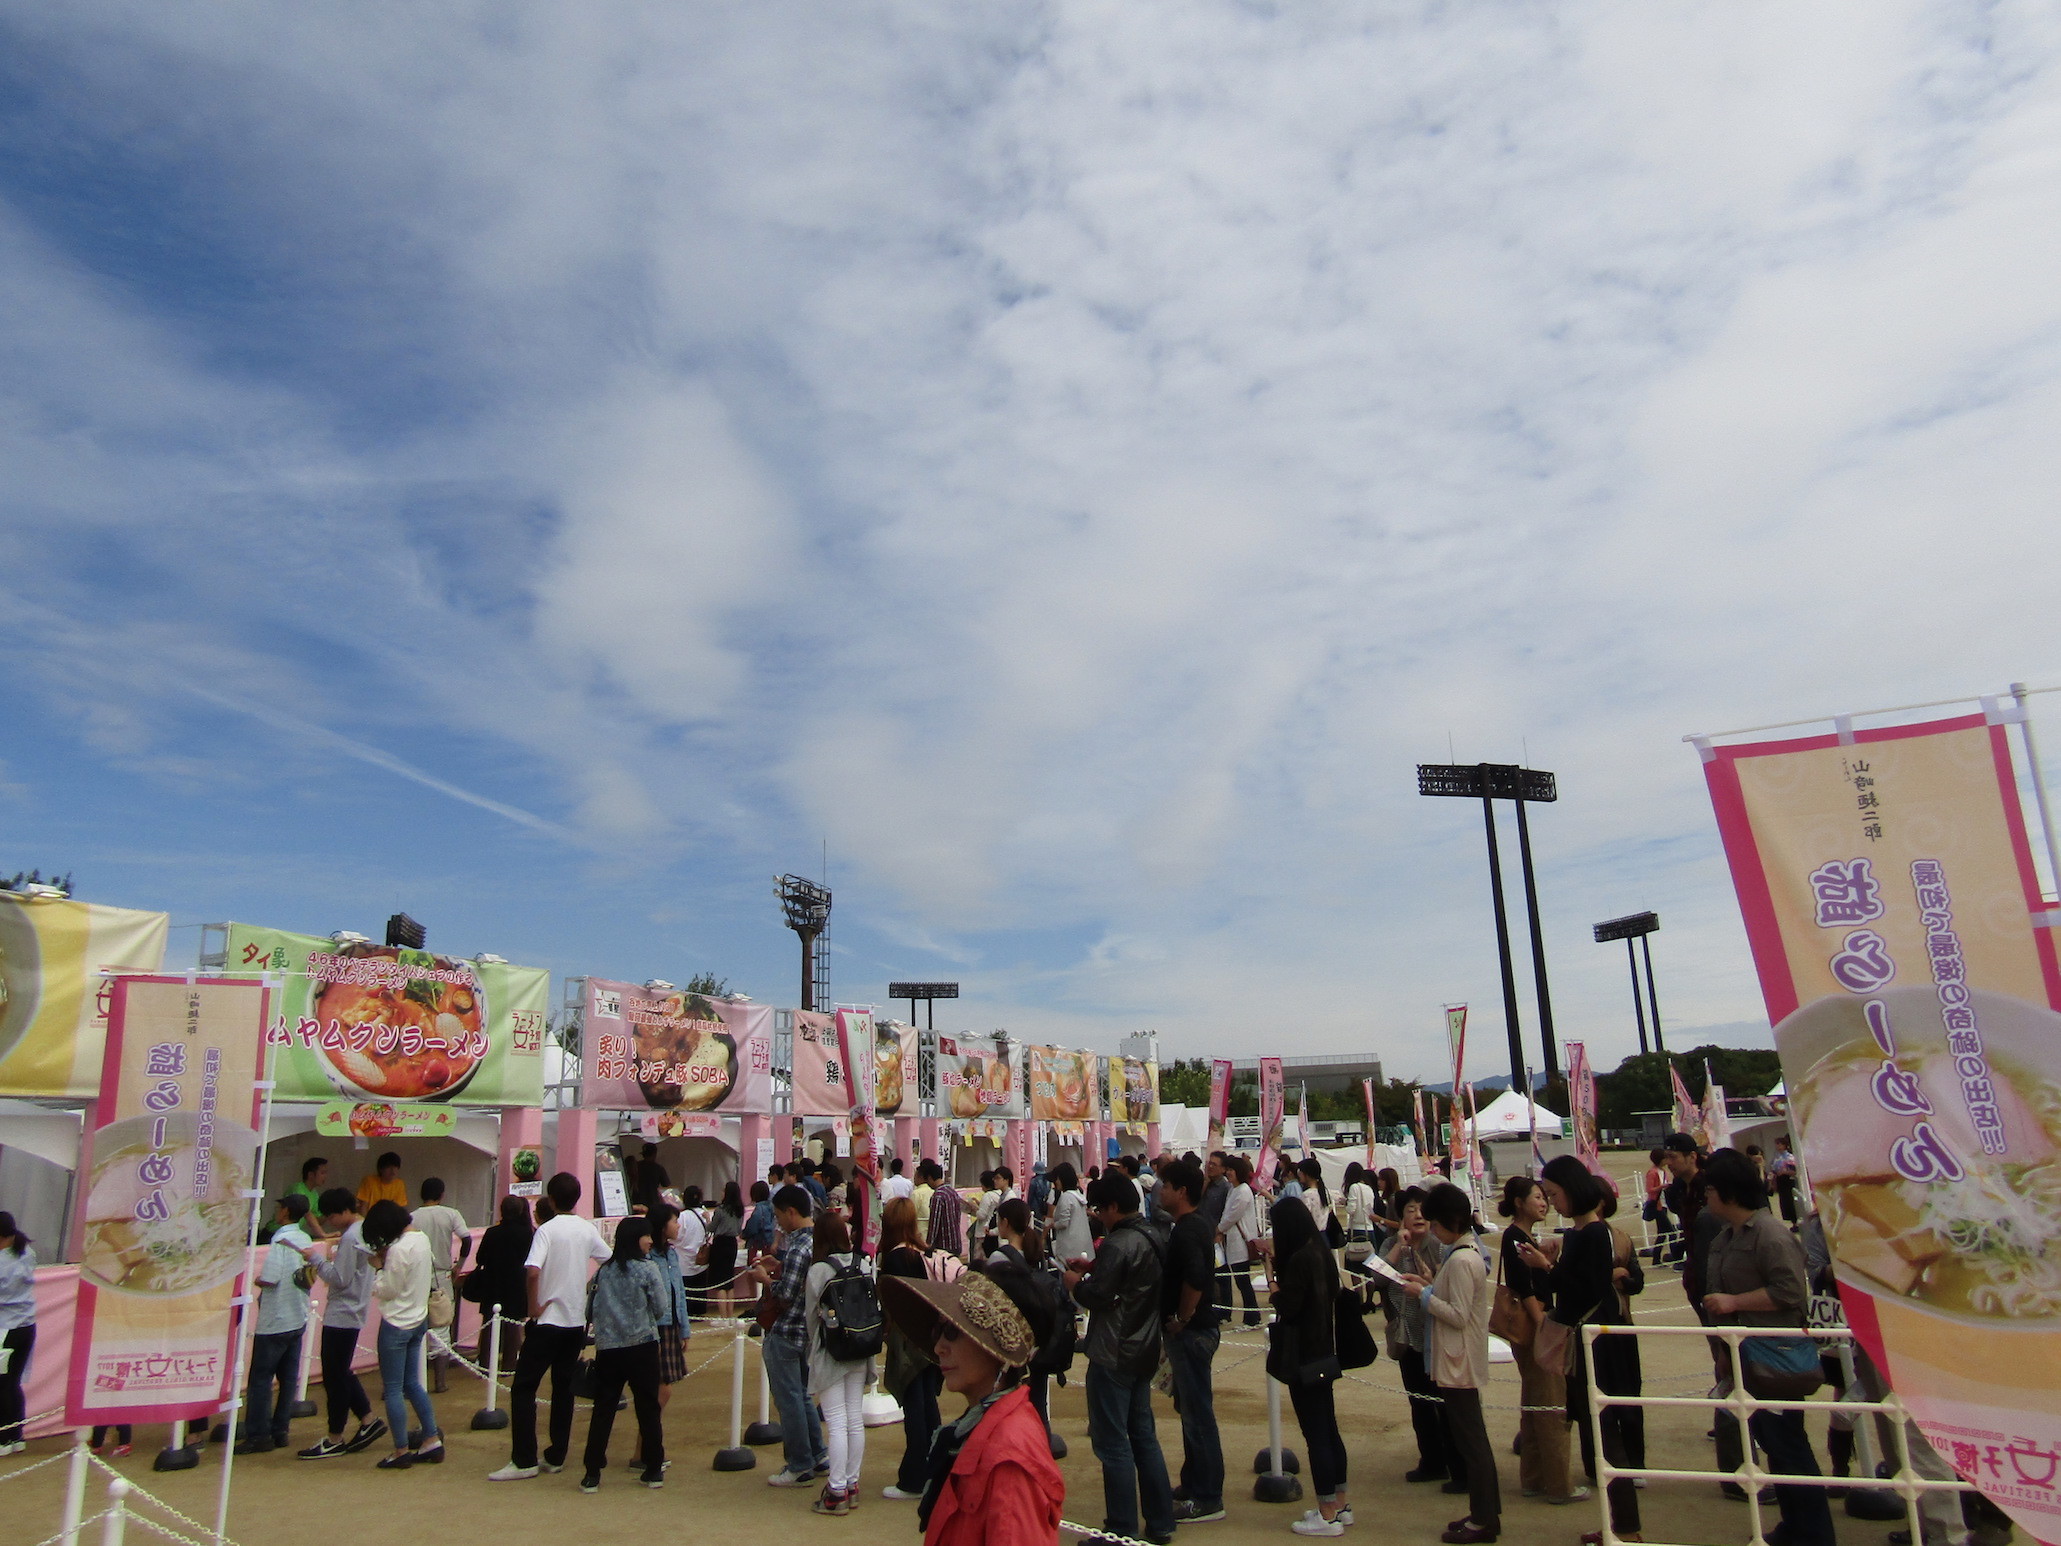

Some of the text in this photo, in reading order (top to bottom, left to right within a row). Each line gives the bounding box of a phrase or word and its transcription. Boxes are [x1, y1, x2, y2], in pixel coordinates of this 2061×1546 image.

[266, 1013, 491, 1060] ムヤムクンラーメン
[691, 1064, 729, 1087] SOBA
